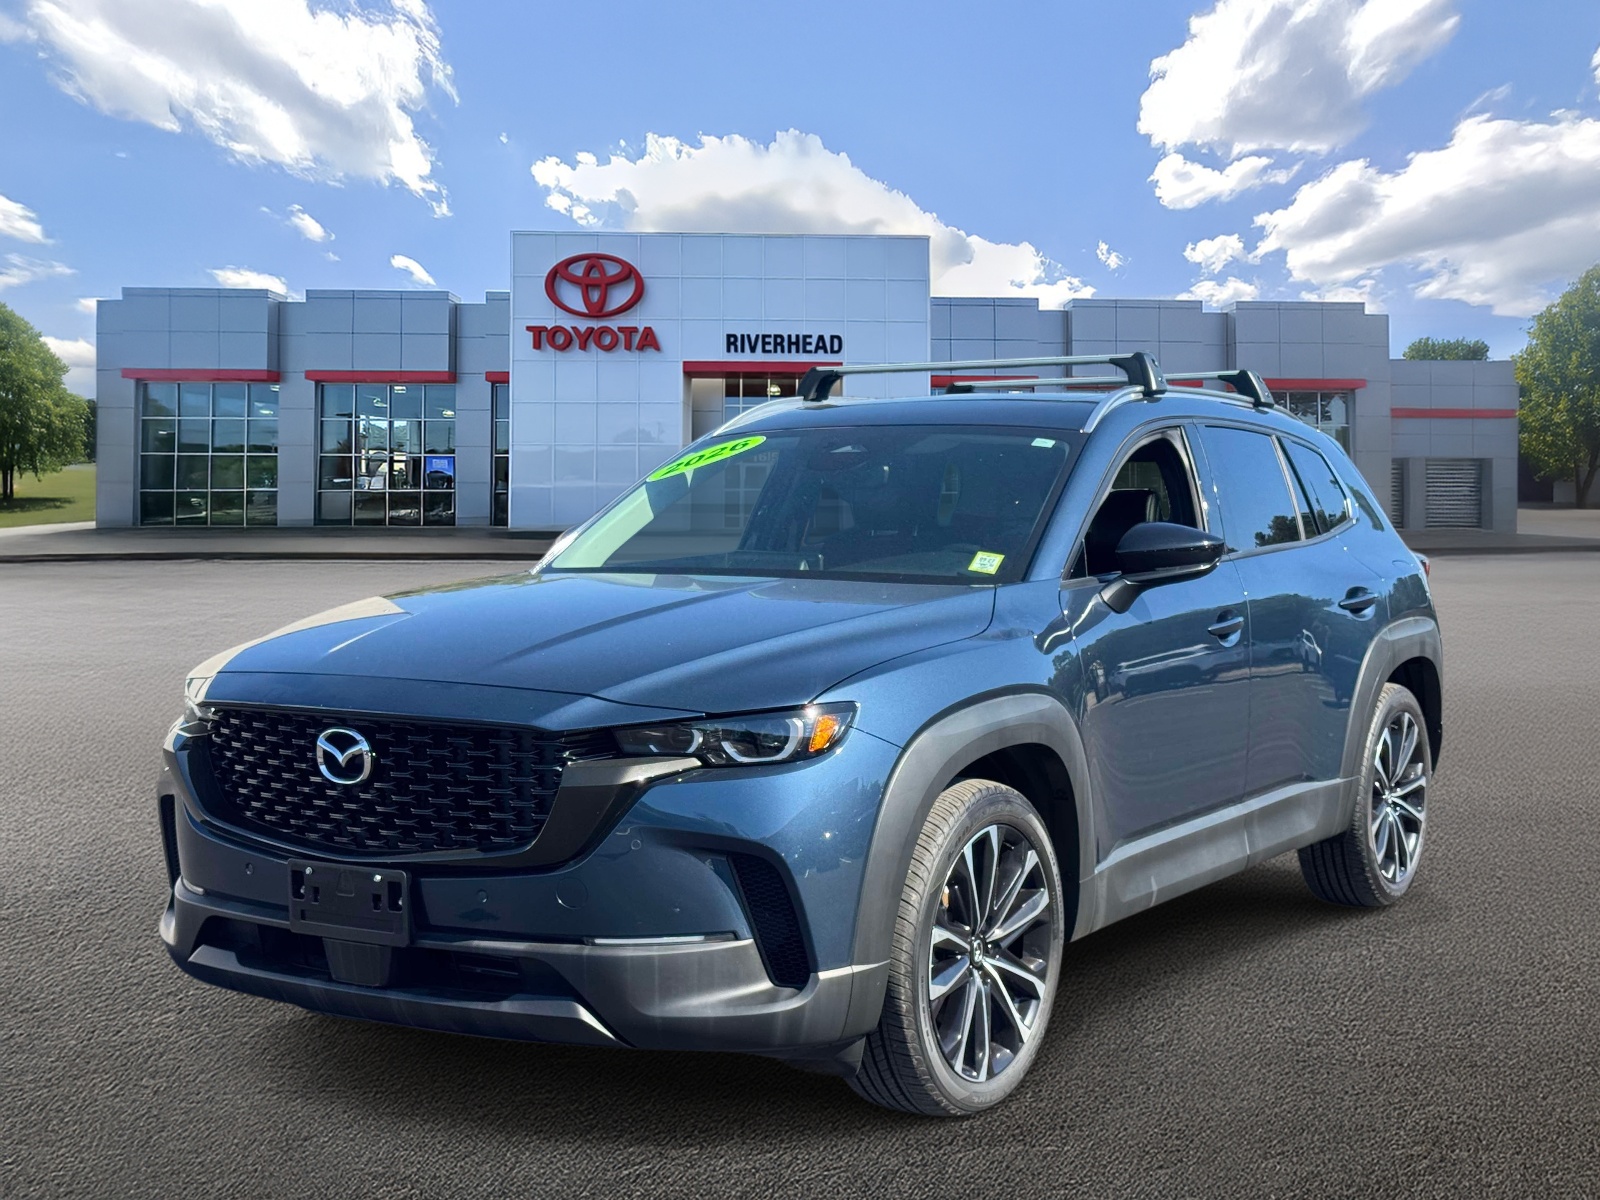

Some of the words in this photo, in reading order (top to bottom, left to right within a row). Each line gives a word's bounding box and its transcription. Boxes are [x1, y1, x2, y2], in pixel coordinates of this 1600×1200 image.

[526, 325, 661, 351] TOYOTA
[725, 333, 844, 355] RIVERHEAD
[659, 439, 752, 478] 2026
